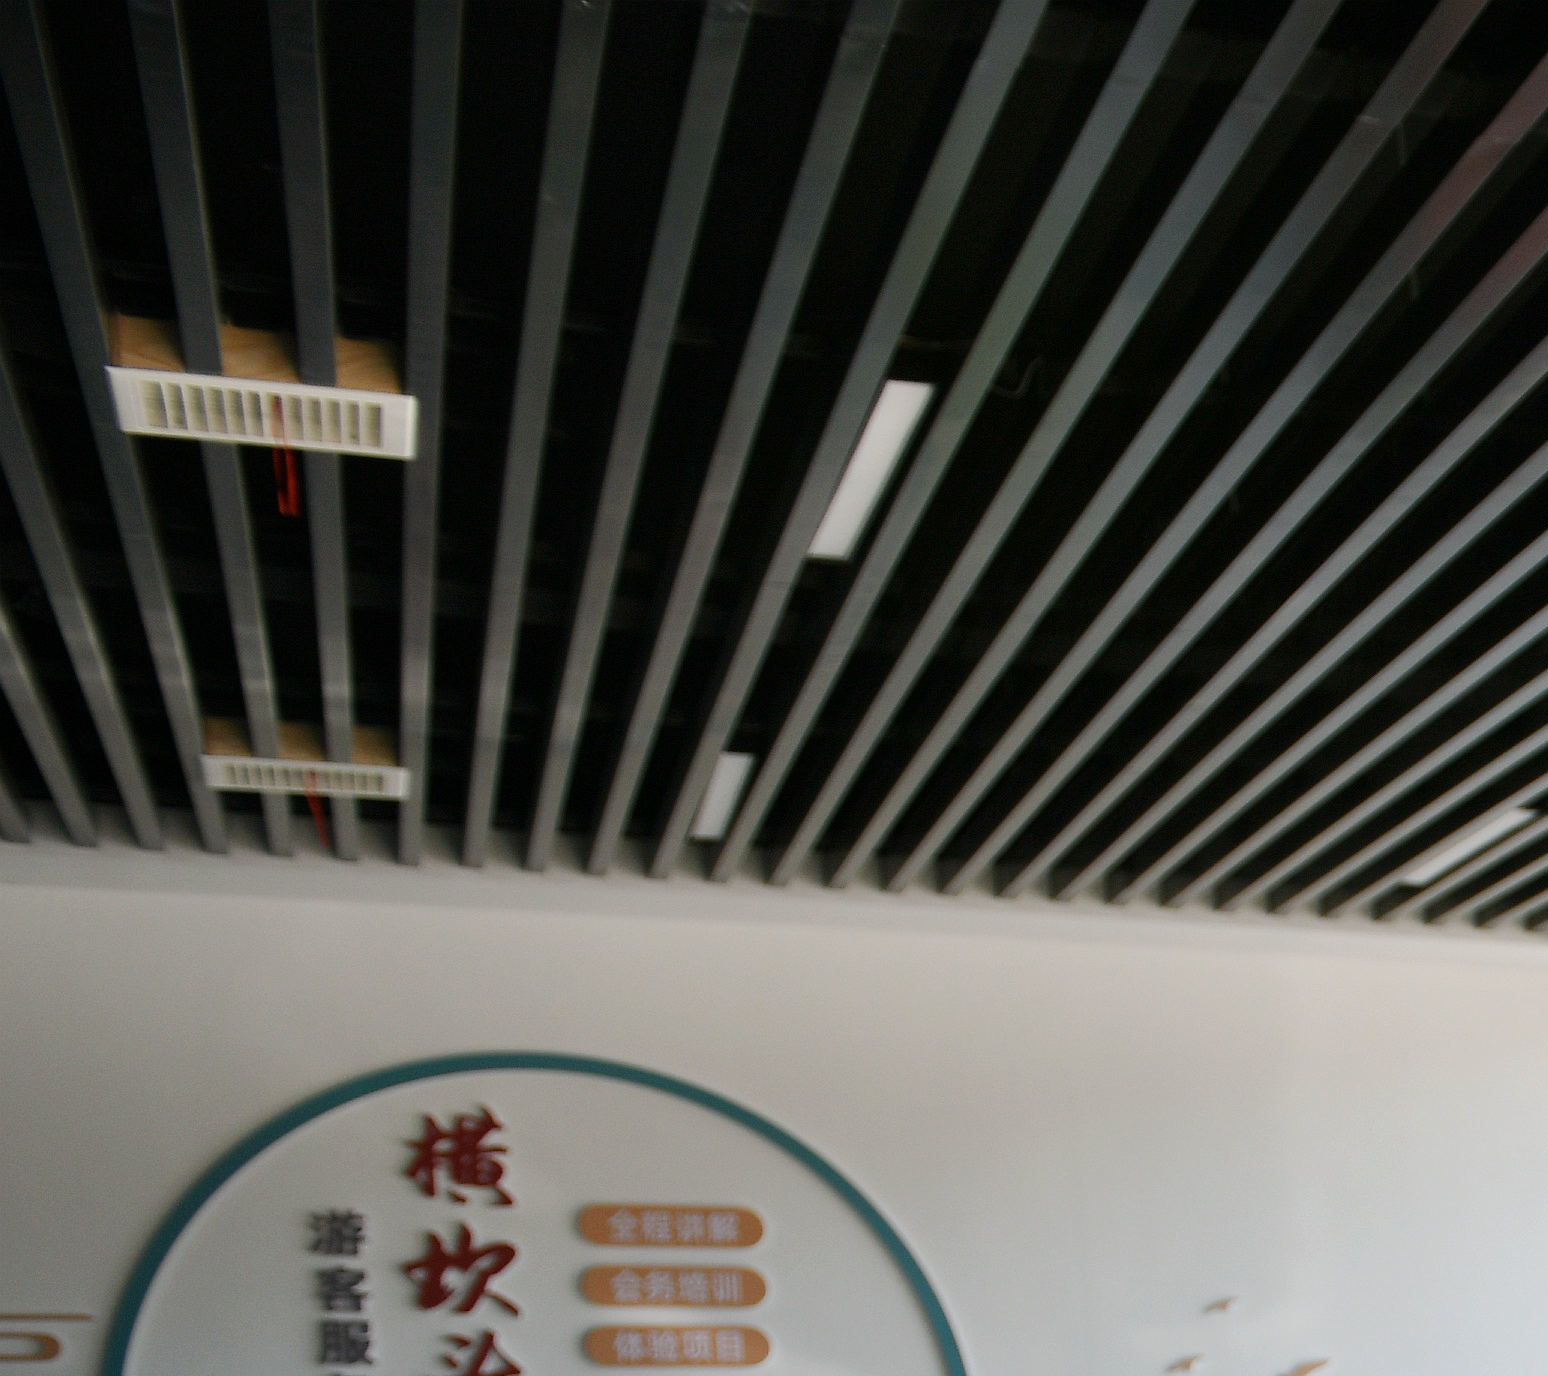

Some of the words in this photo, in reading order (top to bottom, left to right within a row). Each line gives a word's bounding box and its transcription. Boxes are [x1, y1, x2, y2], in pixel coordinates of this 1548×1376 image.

[607, 1207, 740, 1243] 全程讲解
[610, 1269, 744, 1306] 会务培训
[613, 1330, 747, 1364] 体验项目
